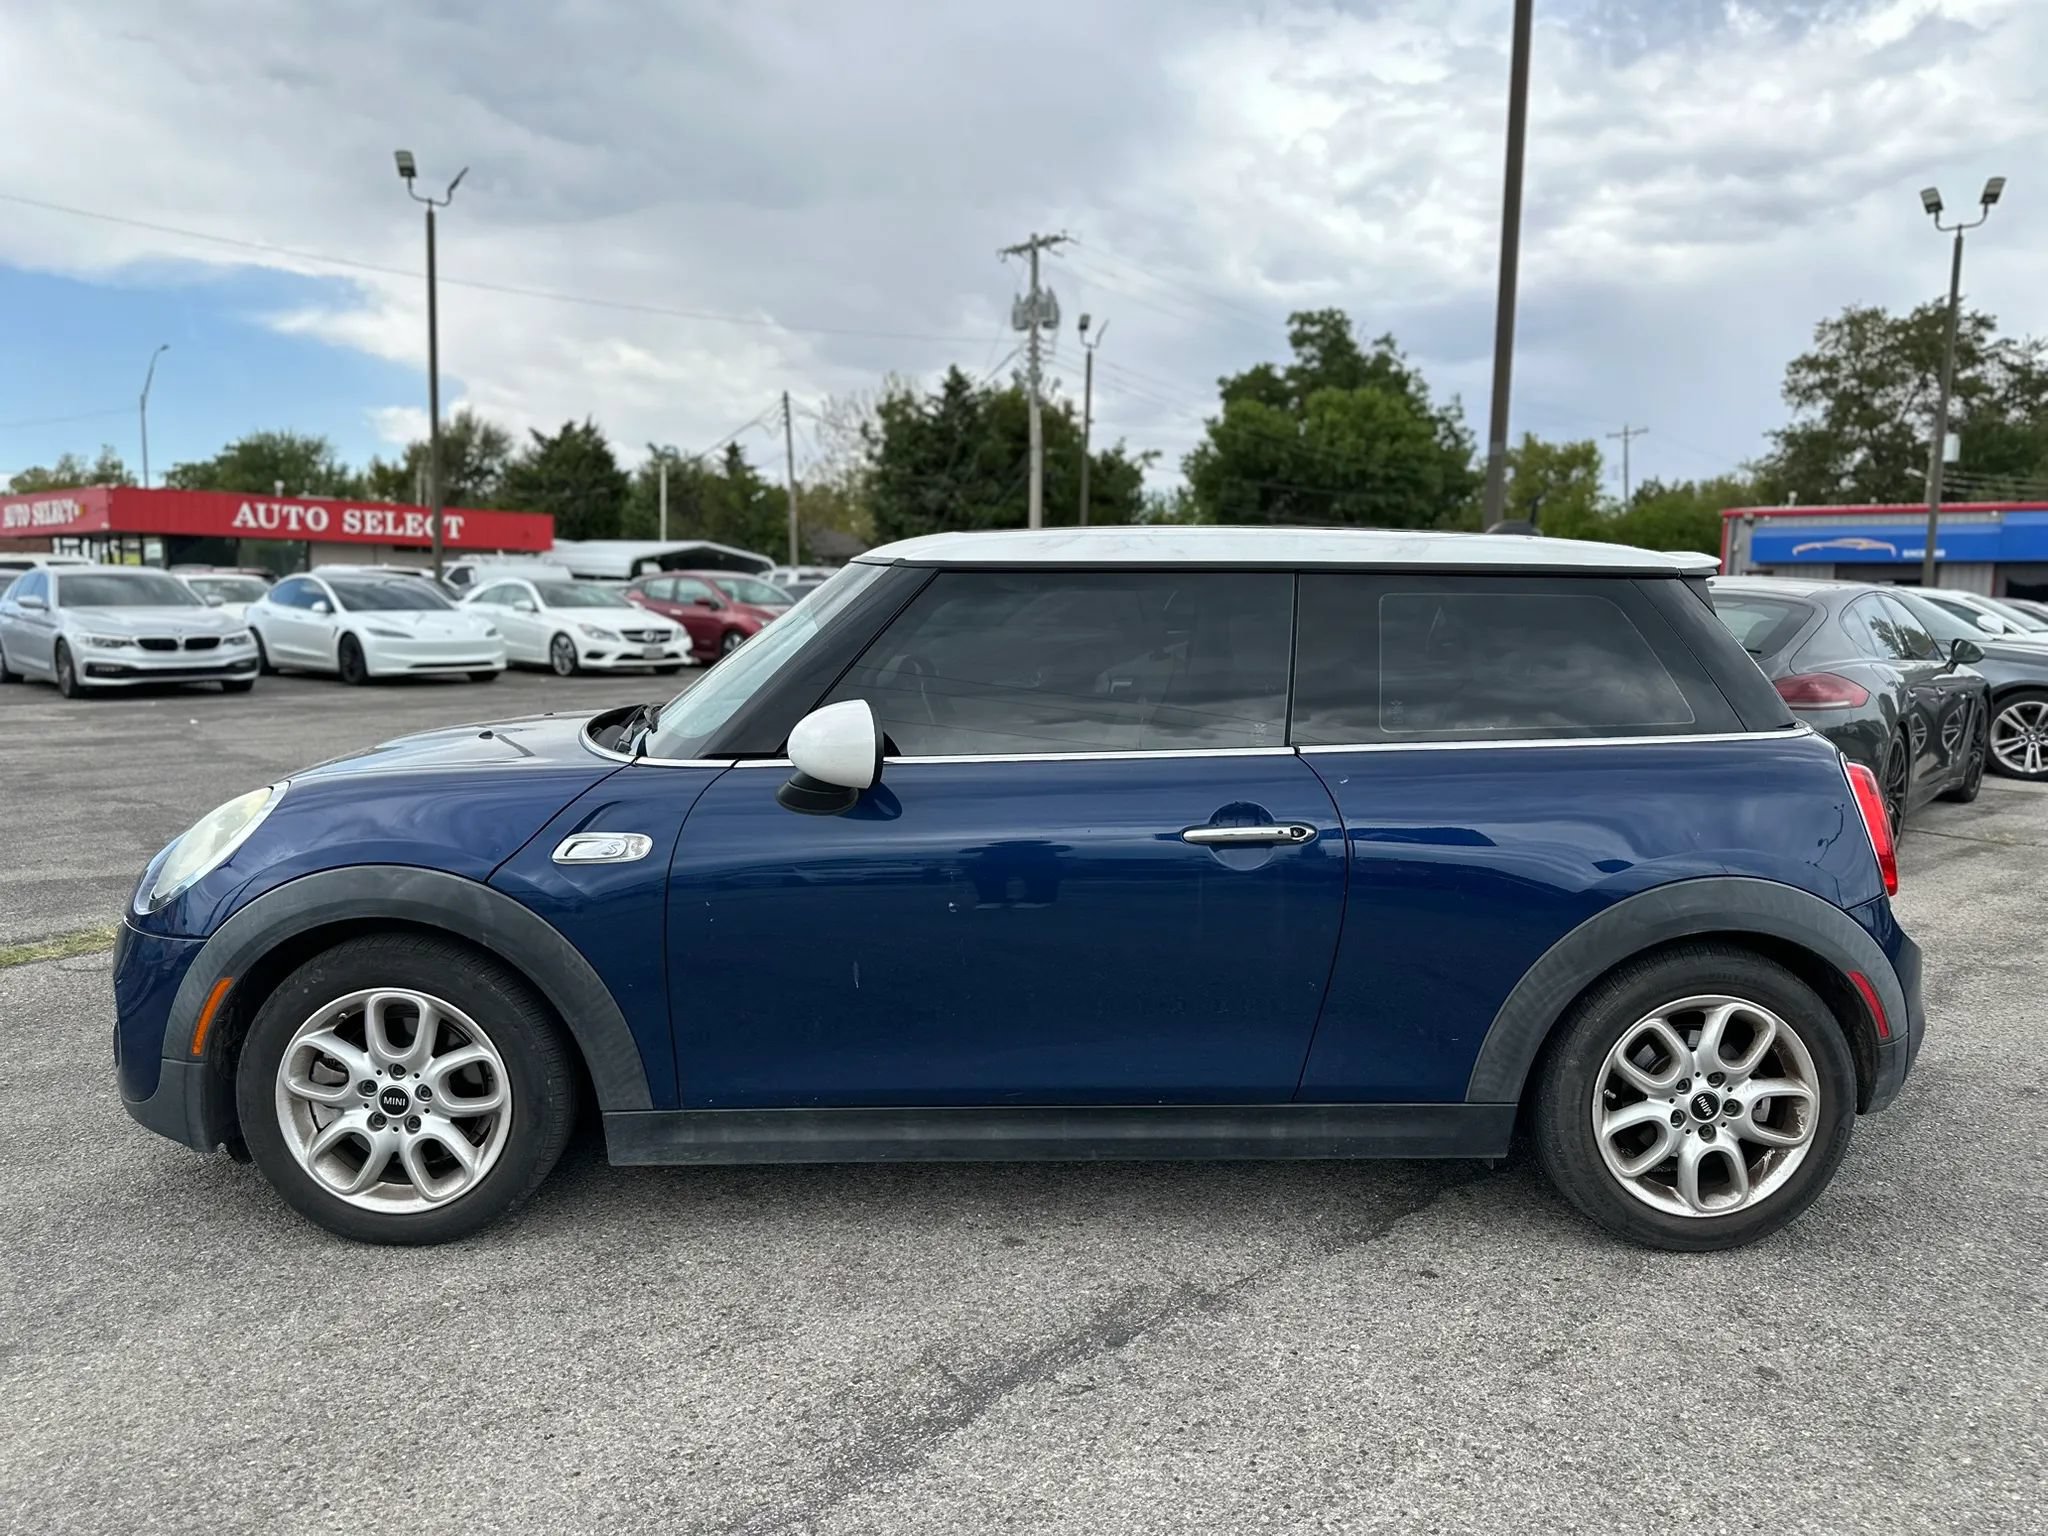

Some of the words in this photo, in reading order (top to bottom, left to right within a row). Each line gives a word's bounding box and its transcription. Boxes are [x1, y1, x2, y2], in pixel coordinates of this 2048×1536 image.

[232, 501, 329, 532] AUTO
[383, 1096, 406, 1106] MINI
[1697, 1095, 1713, 1117] MINI
